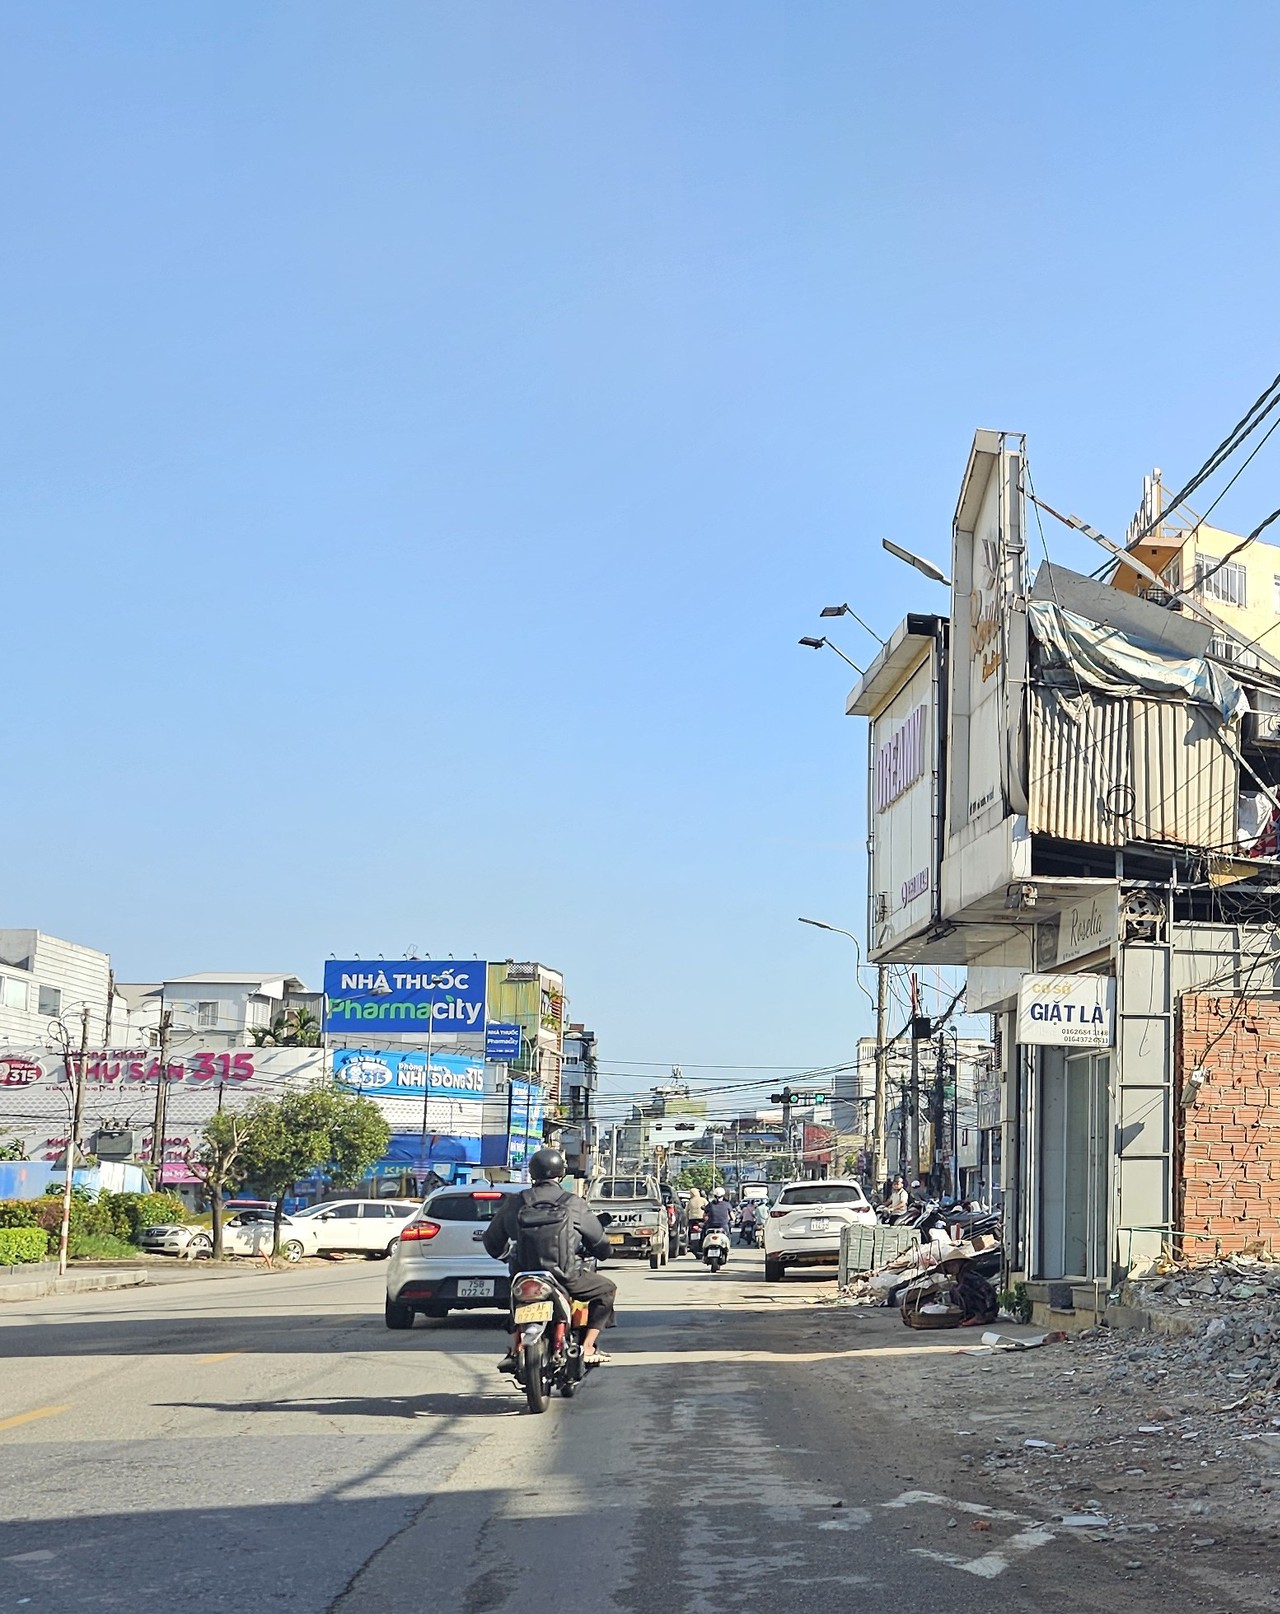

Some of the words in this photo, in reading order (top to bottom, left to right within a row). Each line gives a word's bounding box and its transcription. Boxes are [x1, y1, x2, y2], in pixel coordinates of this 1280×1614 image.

[1071, 899, 1102, 947] Roselia
[341, 970, 390, 989] NHÀ
[393, 968, 469, 989] THUỐC
[327, 997, 482, 1024] Pharmacity
[1031, 1000, 1075, 1025] GIẶT
[1080, 1001, 1104, 1024] LÀ
[9, 1069, 38, 1082] 315
[193, 1053, 254, 1081] 315
[398, 1070, 427, 1087] NHI
[611, 1214, 642, 1223] ZUKI
